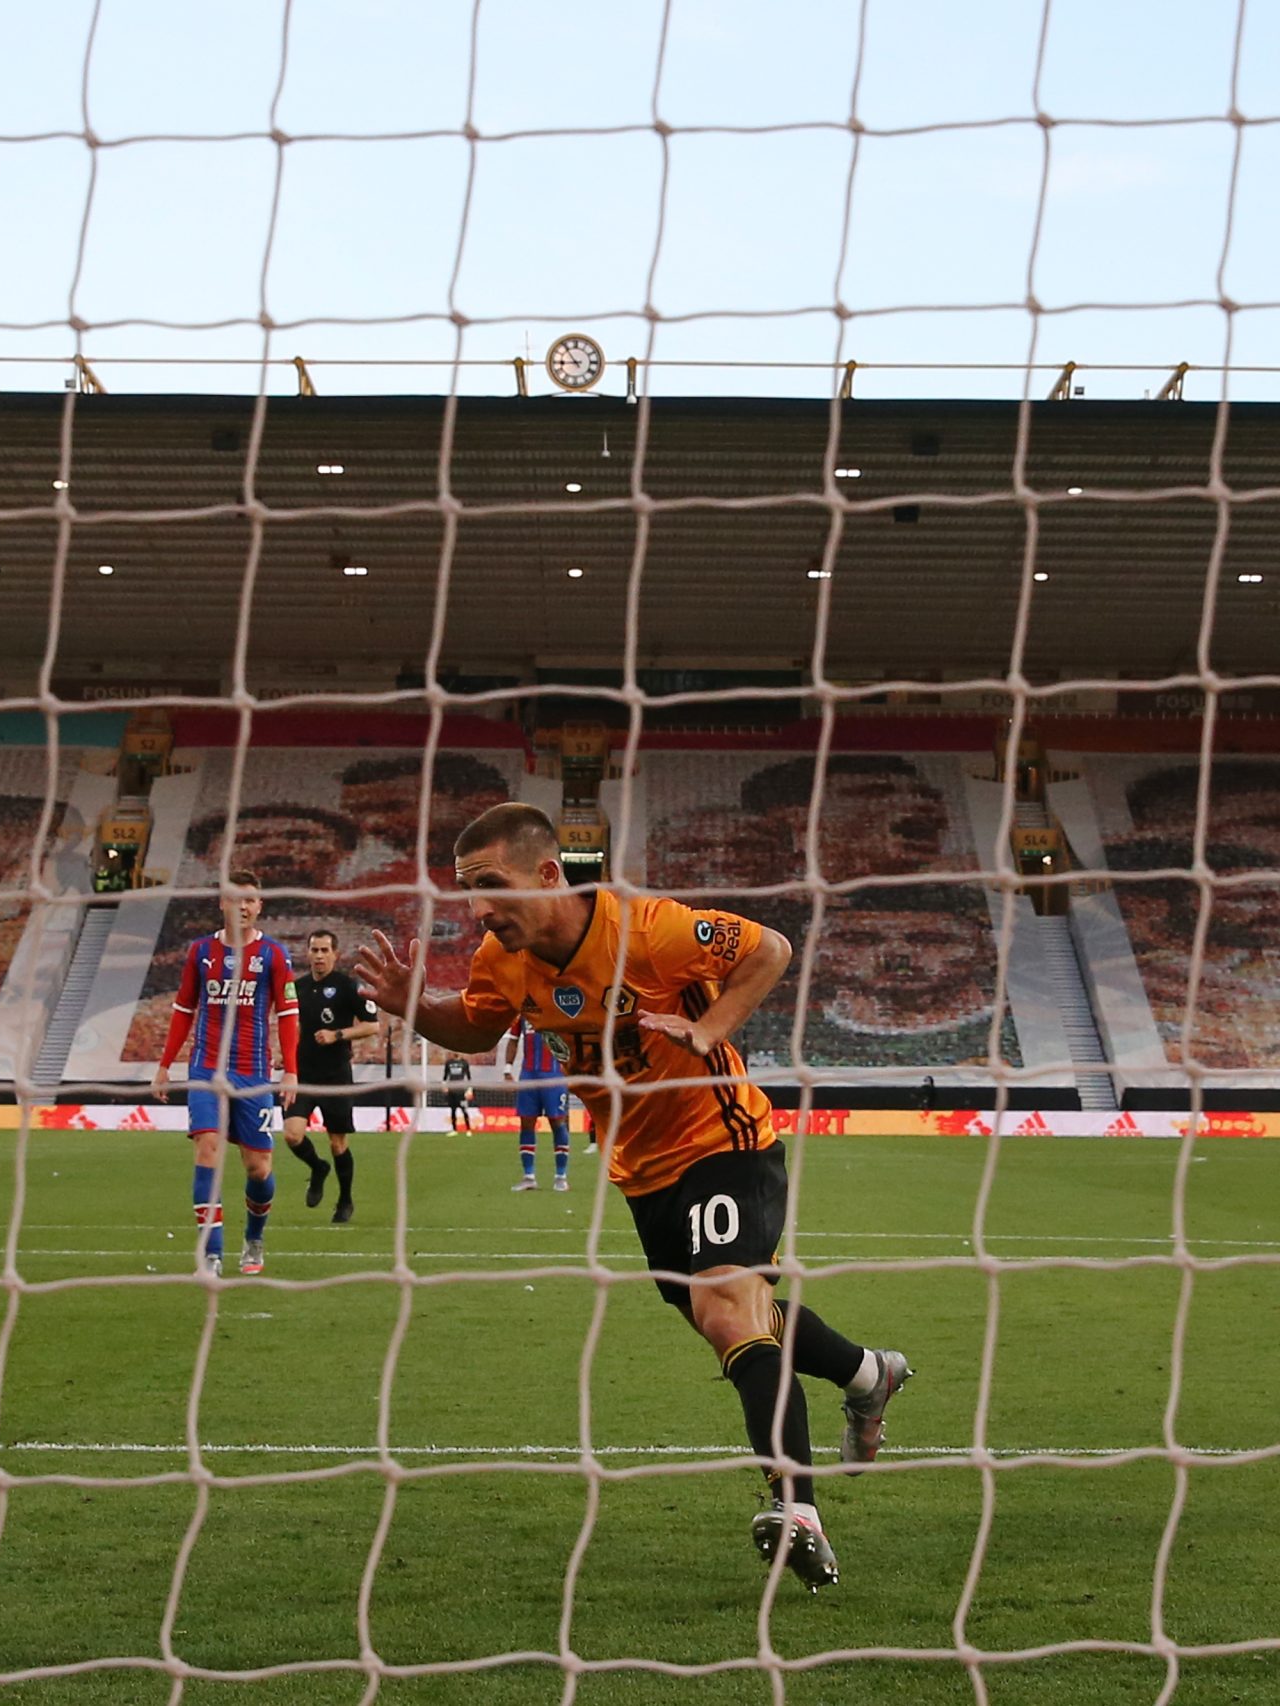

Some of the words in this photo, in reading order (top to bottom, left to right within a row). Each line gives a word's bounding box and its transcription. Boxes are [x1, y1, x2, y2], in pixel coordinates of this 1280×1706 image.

[83, 687, 146, 700] FOSUN
[113, 828, 136, 840] SL2
[569, 832, 591, 842] SL3
[1024, 835, 1048, 846] SL4
[560, 995, 580, 1005] NHS
[772, 1110, 850, 1136] PORT
[688, 1193, 740, 1255] 10
